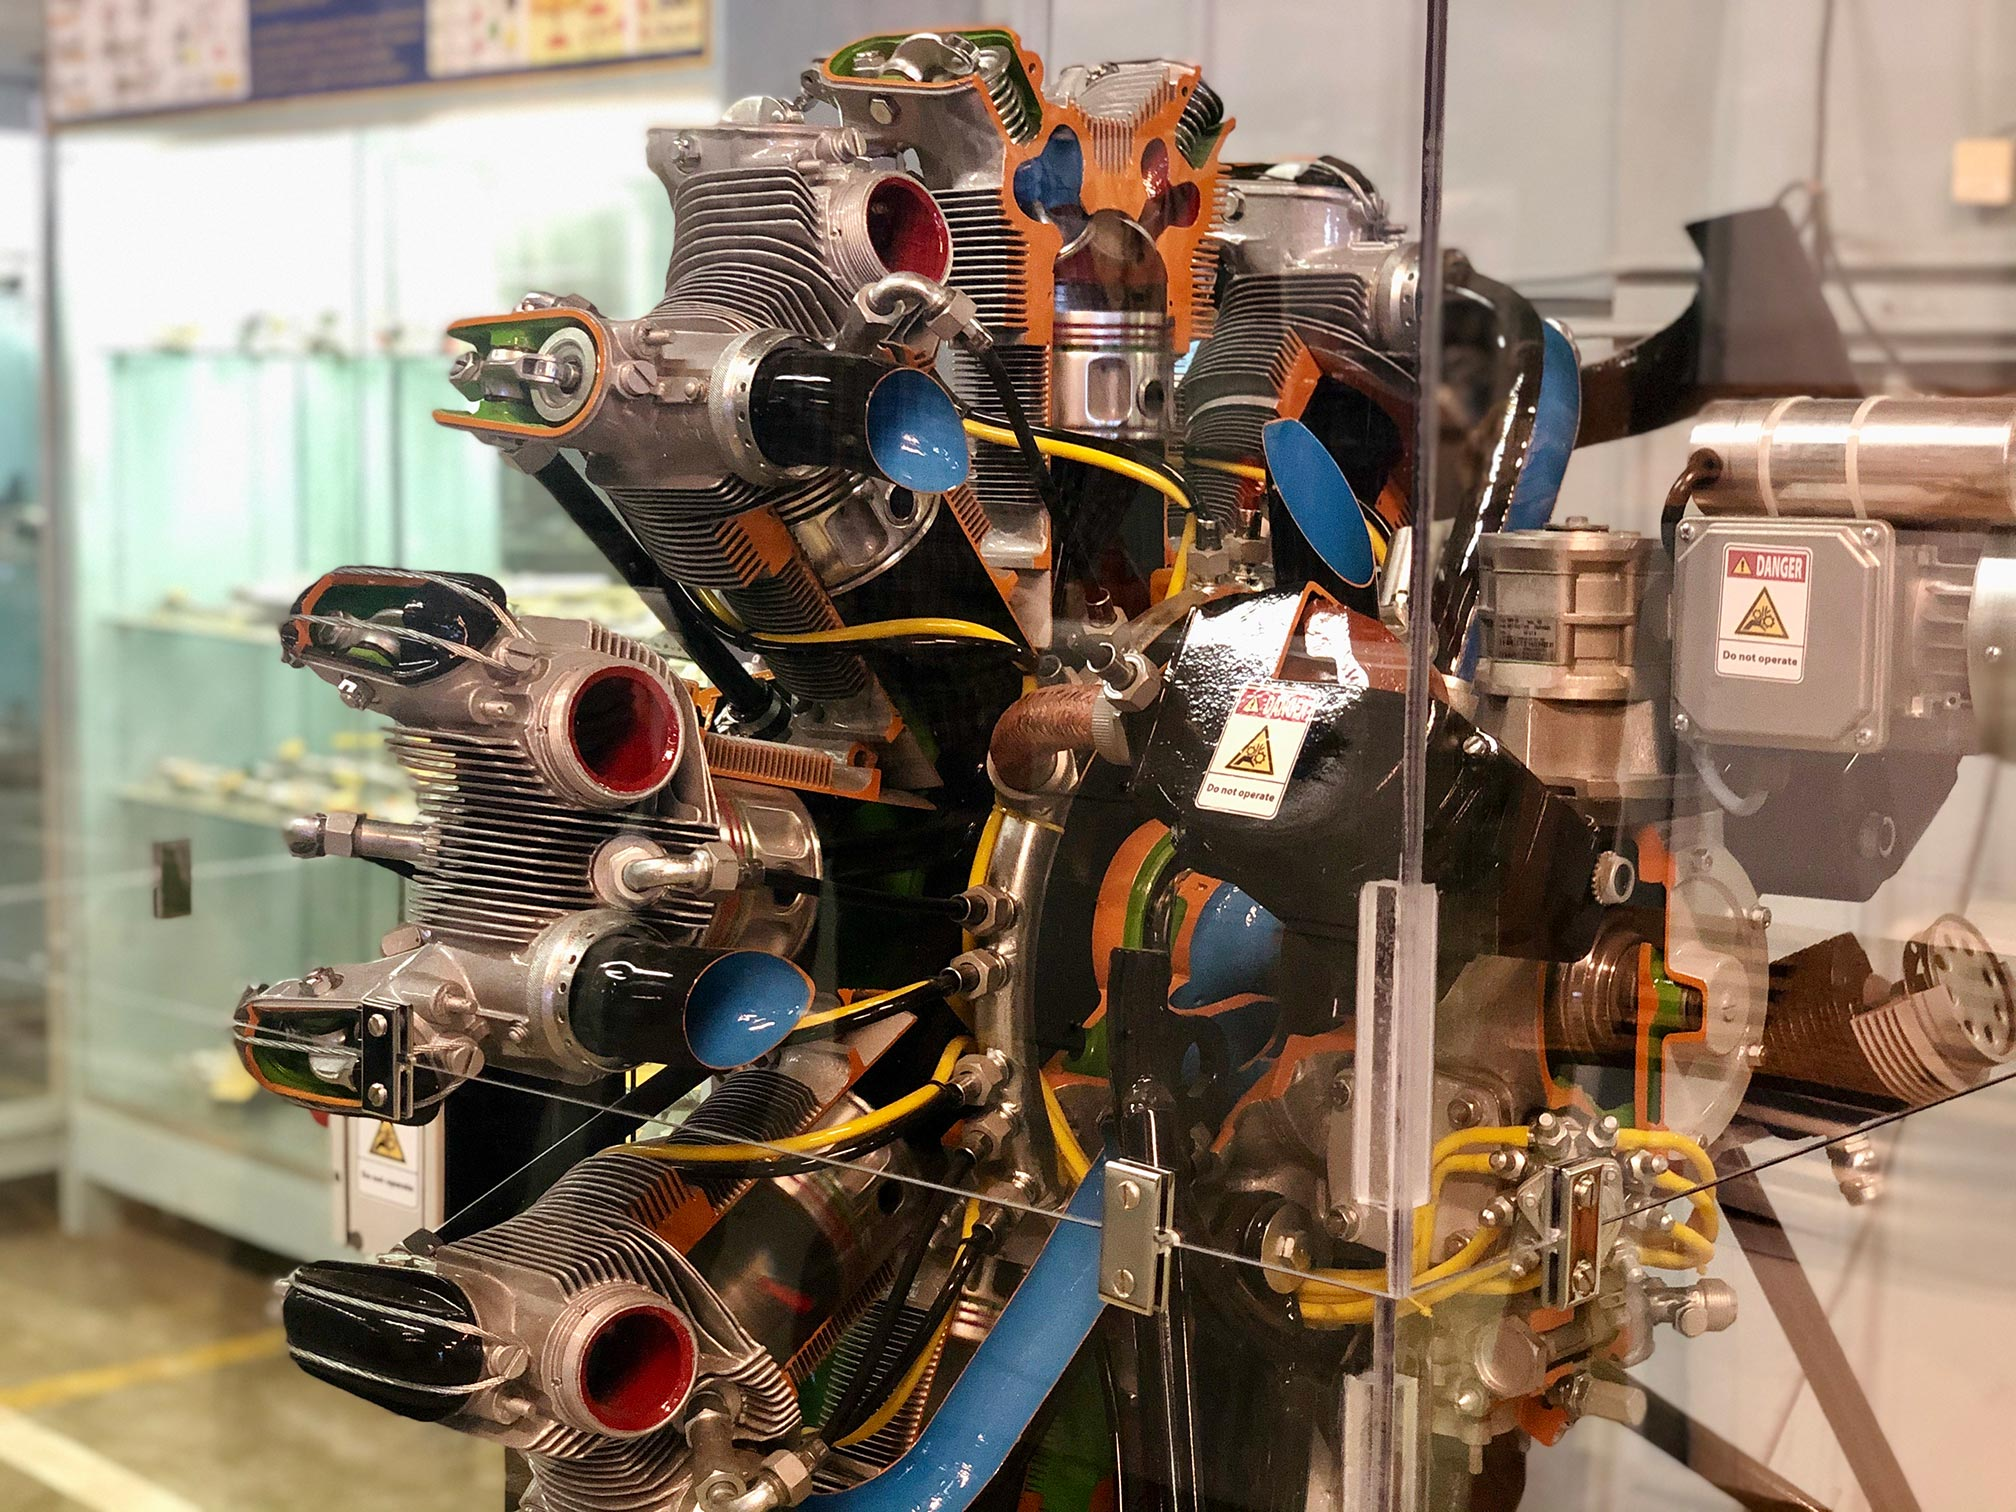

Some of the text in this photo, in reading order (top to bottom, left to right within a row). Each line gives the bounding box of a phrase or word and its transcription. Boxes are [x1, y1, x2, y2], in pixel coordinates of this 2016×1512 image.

[1756, 554, 1803, 579] DANGER
[1722, 650, 1798, 666] Do not operate
[1206, 783, 1275, 802] Do not operate
